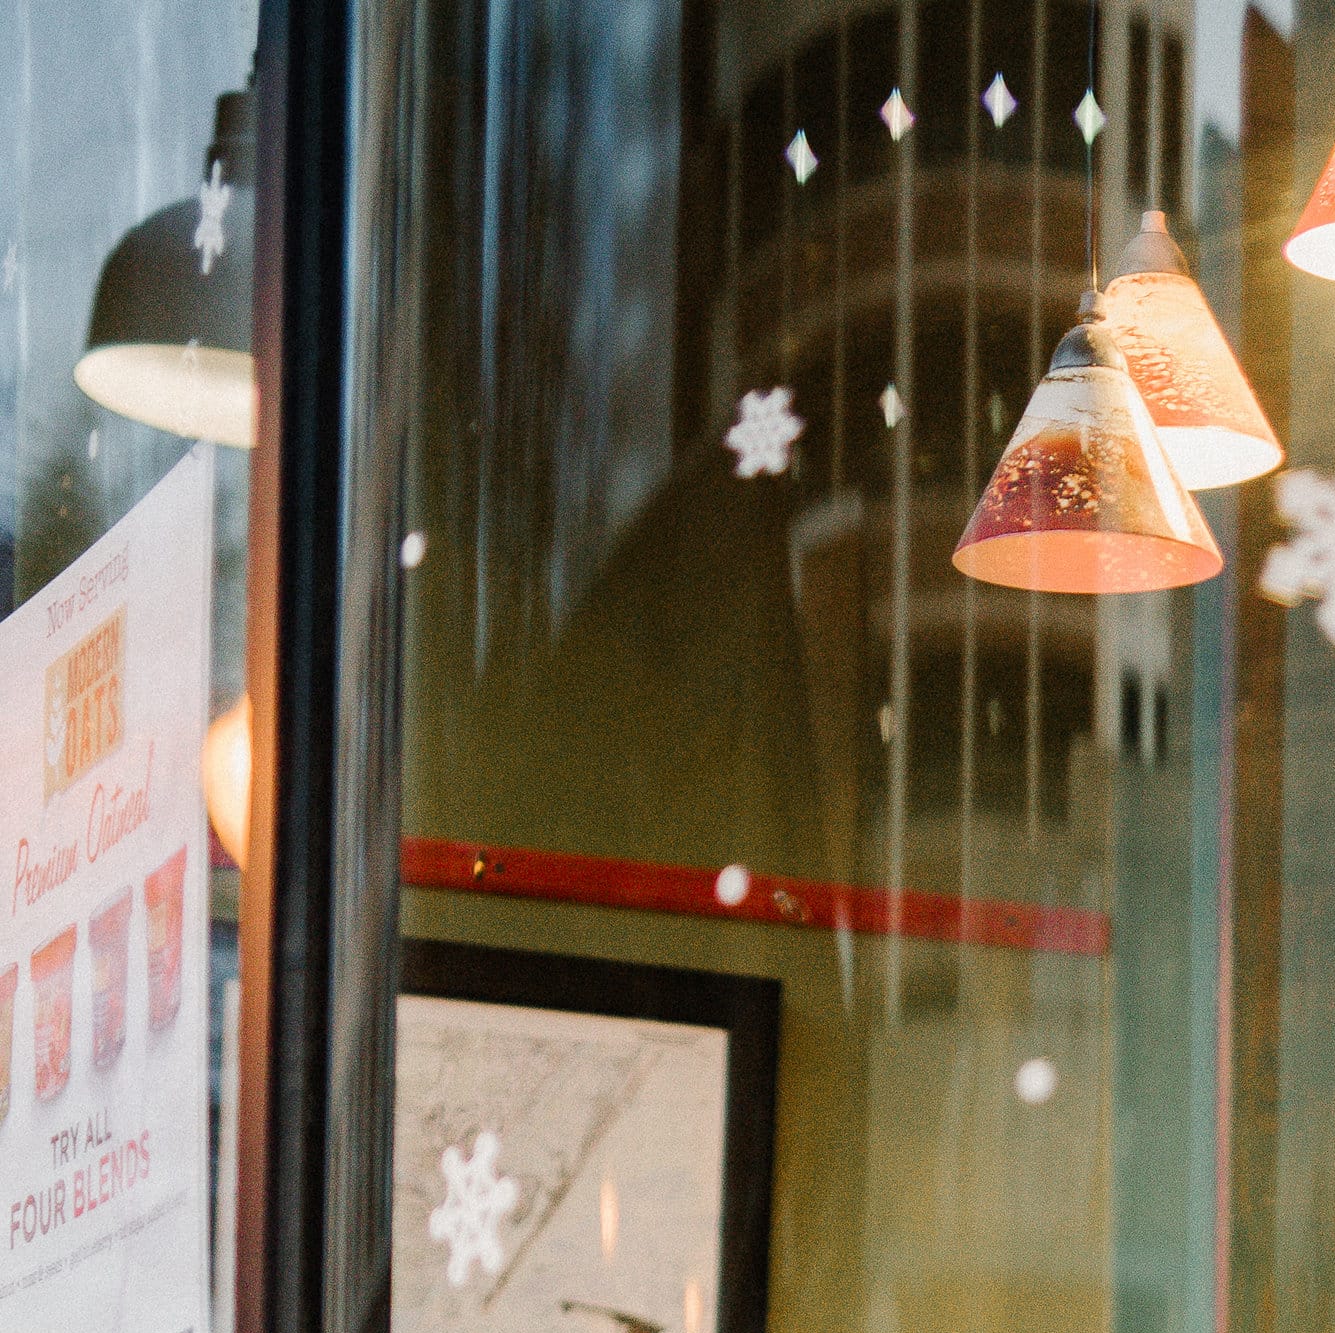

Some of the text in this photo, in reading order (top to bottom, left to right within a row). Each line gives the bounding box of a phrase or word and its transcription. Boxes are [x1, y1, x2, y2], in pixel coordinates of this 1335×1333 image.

[46, 540, 130, 638] Now Serving
[66, 614, 120, 701] MODERN
[65, 674, 119, 779] OATS
[12, 740, 154, 917] Premium Oatmeal
[10, 1178, 67, 1250] FOUR
[73, 1127, 150, 1219] BLENDS
[50, 1106, 112, 1170] TRY ALL
